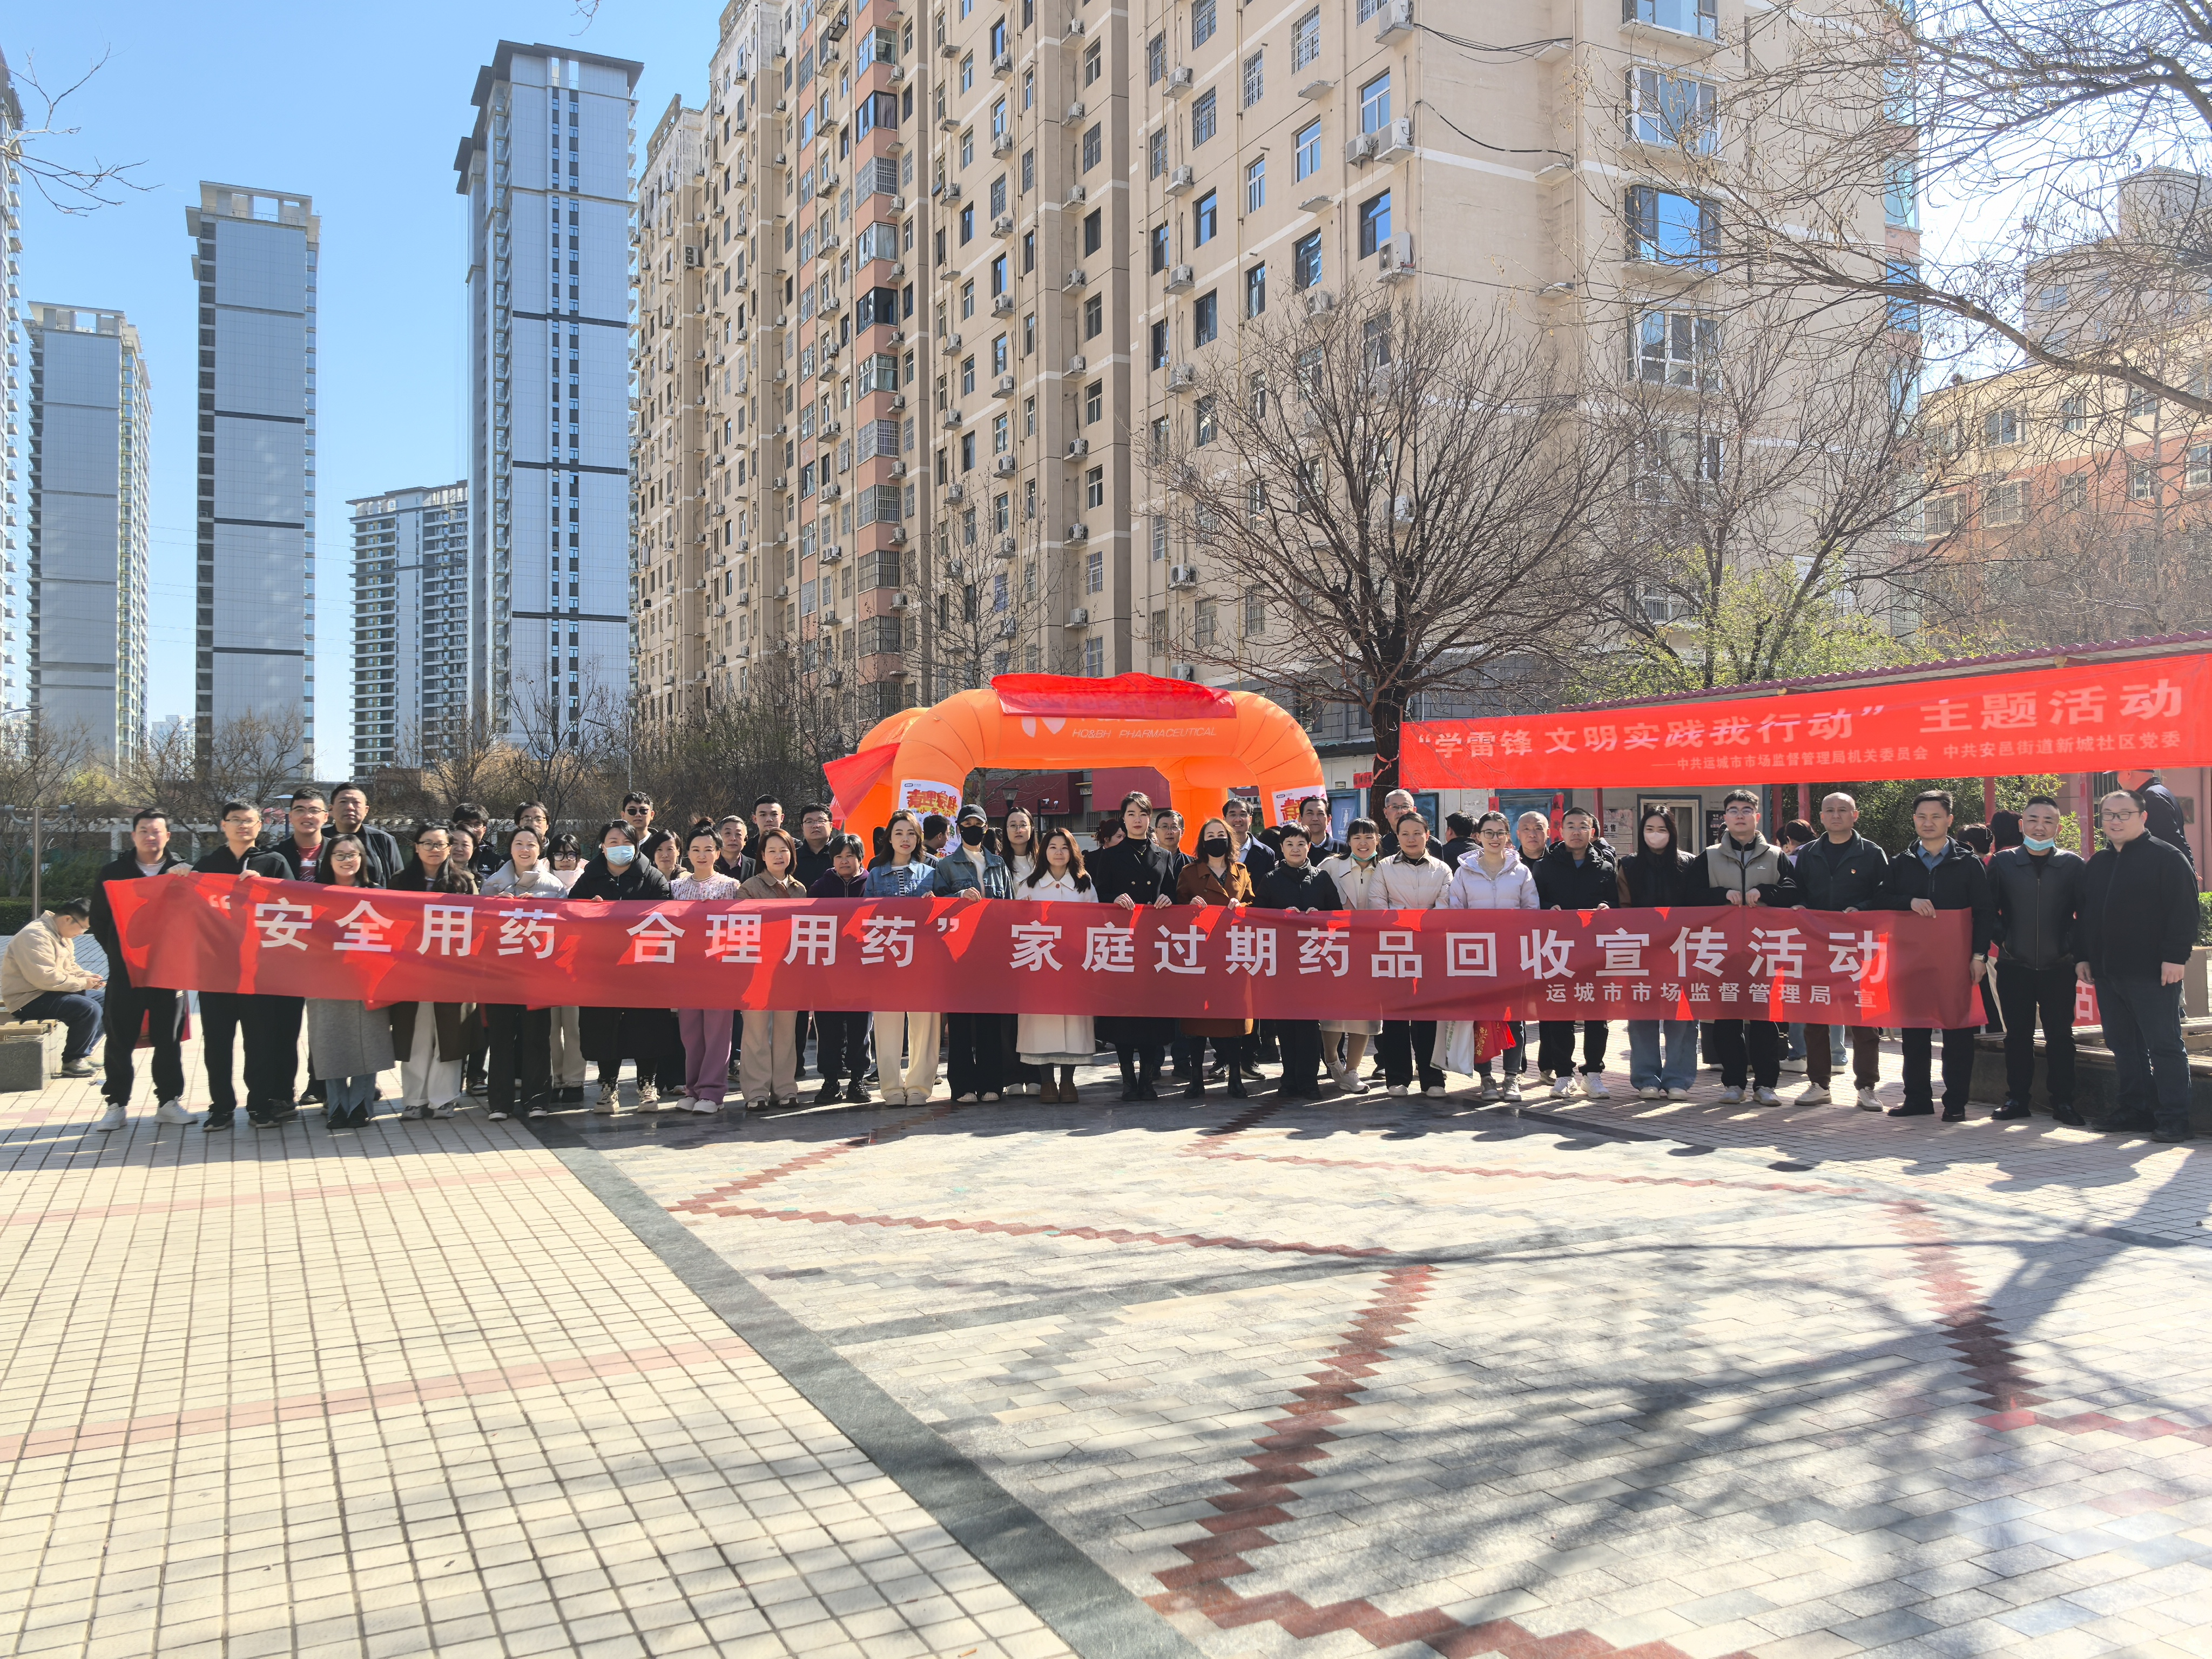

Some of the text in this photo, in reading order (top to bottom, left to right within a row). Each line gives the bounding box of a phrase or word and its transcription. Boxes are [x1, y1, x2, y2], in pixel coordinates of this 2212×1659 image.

[1919, 679, 2182, 733] 主题活动
[1118, 727, 1217, 739] PHARMACEUTICAL
[1944, 730, 2181, 760] 中共安邑街道新城社区党委
[208, 894, 1889, 982] “安全用药 合理用药” 家庭过期药品回收宣传活动
[1546, 982, 1876, 1008] 运城市市场监督管理局 宣
